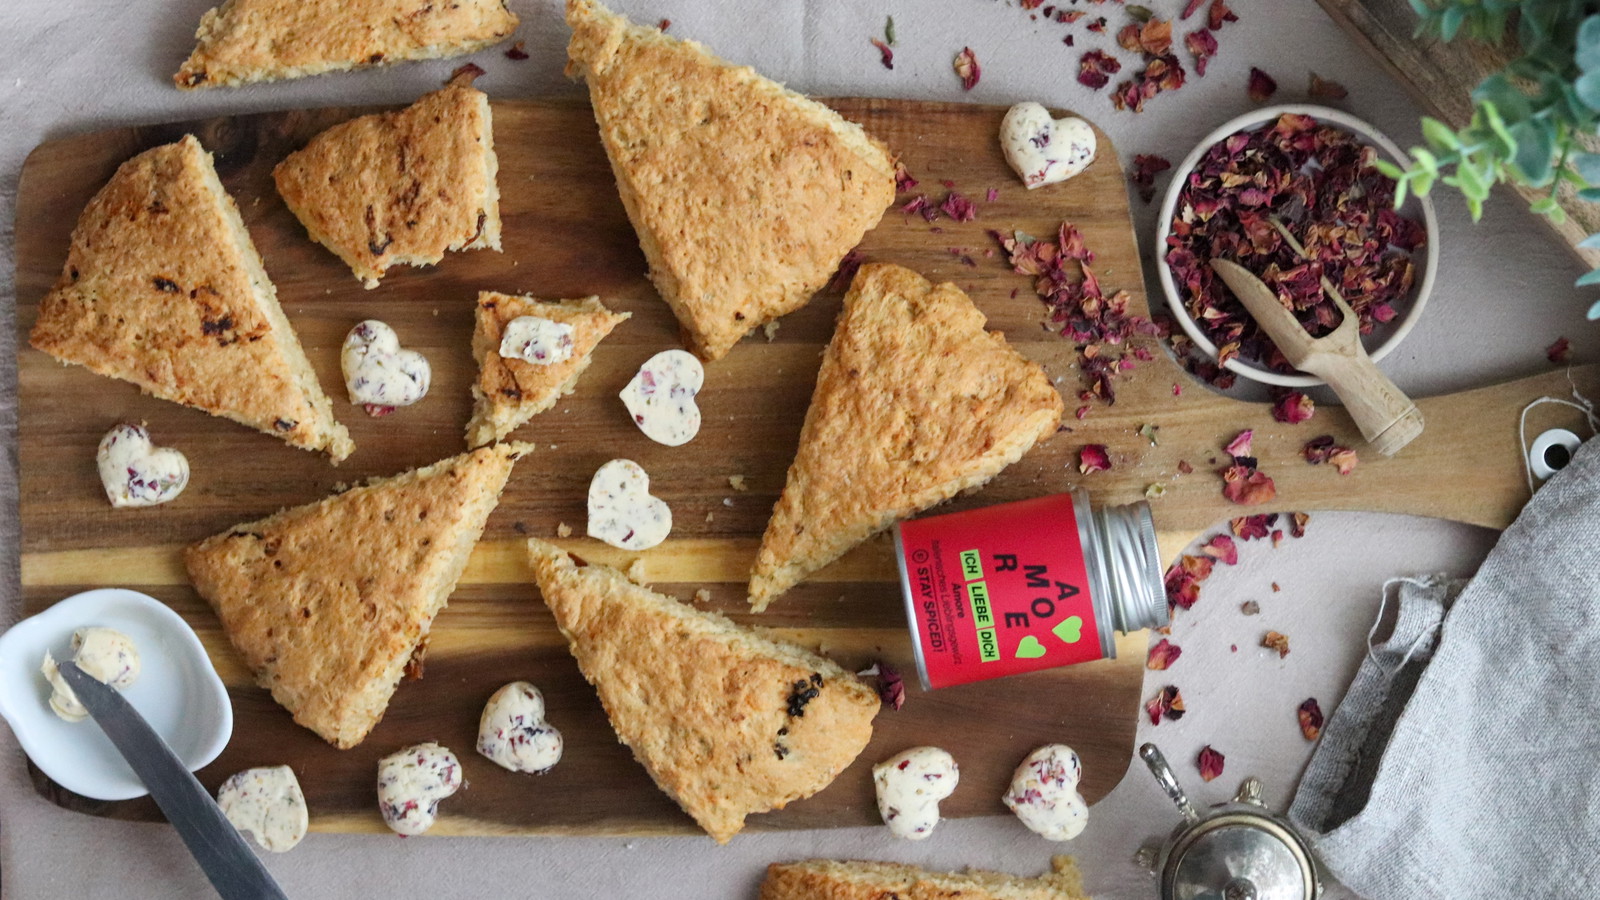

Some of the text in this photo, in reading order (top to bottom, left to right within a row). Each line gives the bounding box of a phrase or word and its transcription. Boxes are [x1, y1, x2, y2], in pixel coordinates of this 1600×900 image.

[917, 567, 932, 598] STAY
[952, 582, 965, 618] Amore
[923, 601, 943, 653] SPICED!
[964, 553, 996, 658] ICH LIEBE DICH
